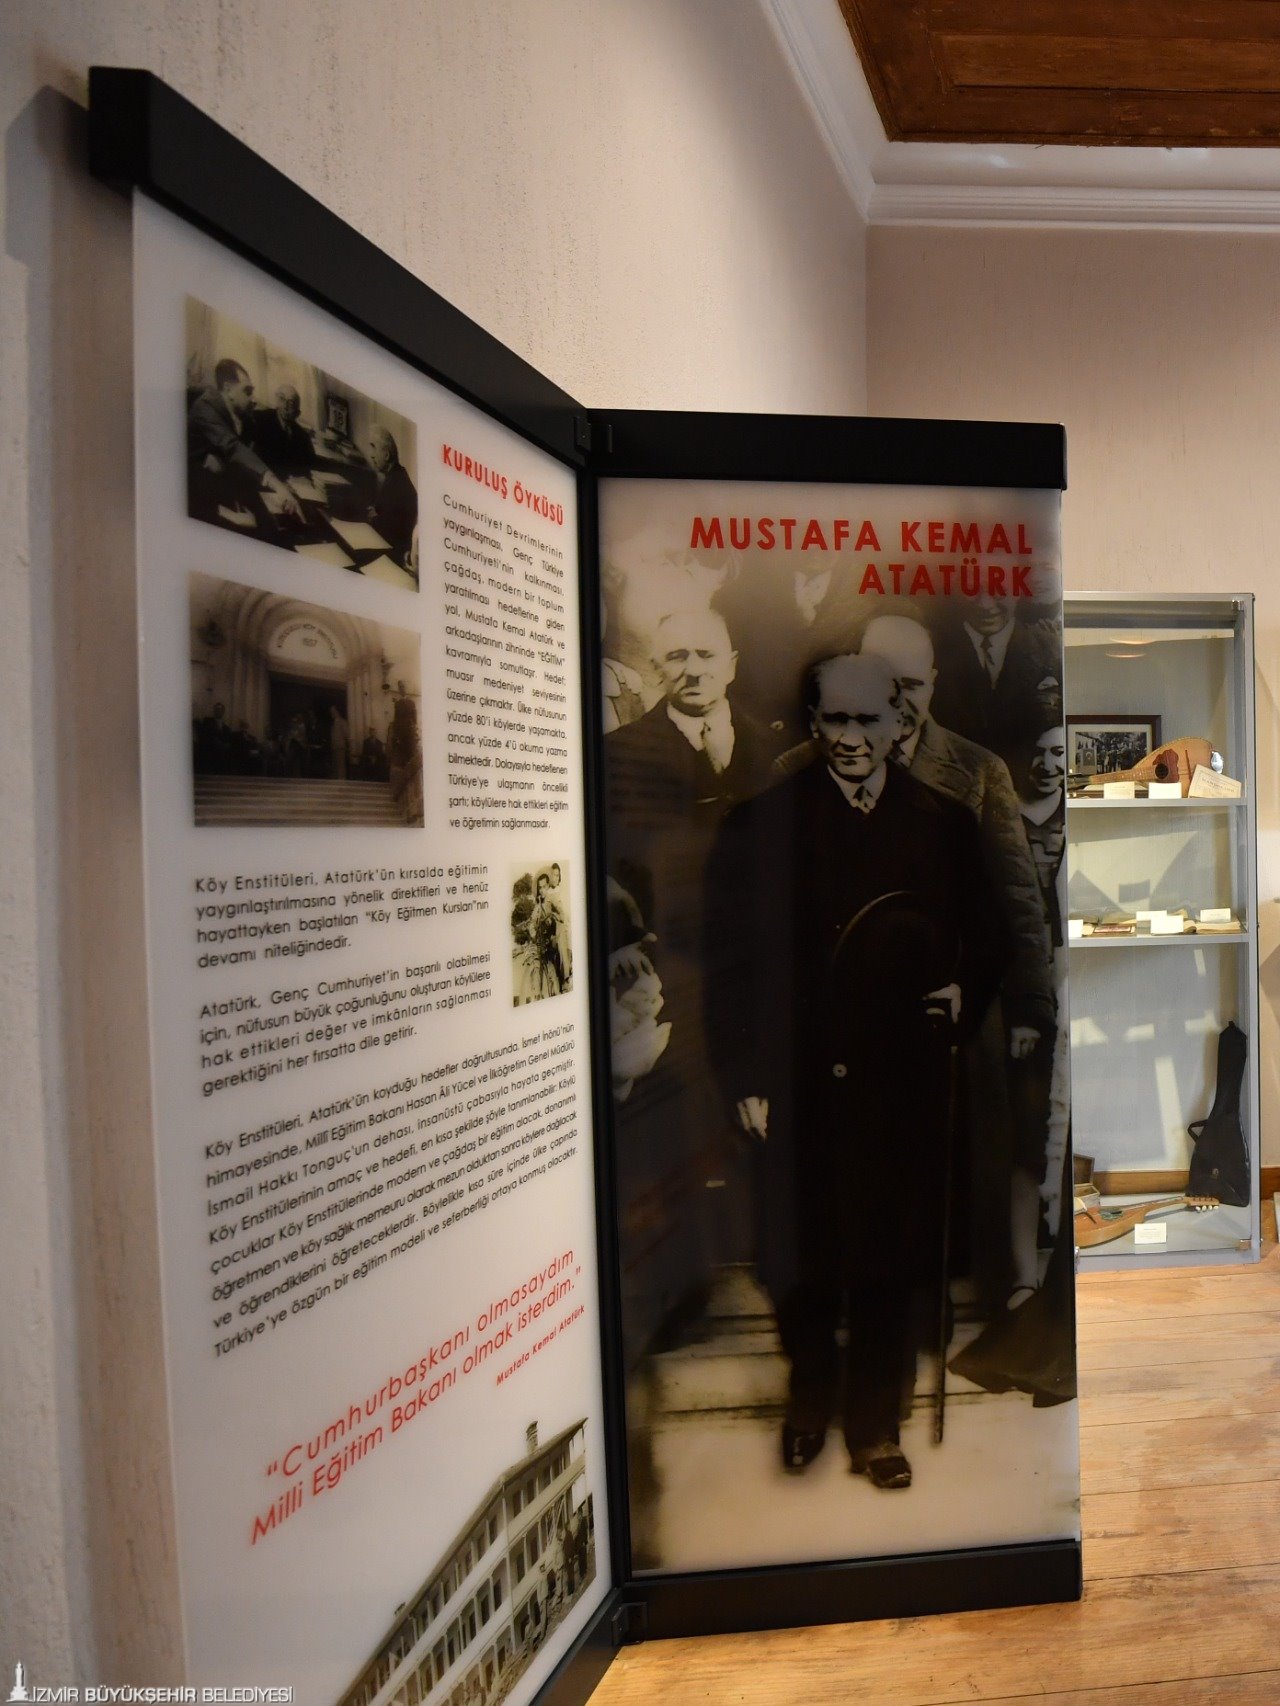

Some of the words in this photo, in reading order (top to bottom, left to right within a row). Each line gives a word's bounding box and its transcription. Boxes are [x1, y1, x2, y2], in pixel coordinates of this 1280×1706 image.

[442, 444, 508, 499] KURULUŞ
[513, 481, 564, 526] ÖYKÜSÜ
[690, 517, 881, 552] MUSTAFA
[901, 521, 1033, 555] KEMAL
[858, 557, 1033, 597] ATATÜRK
[194, 876, 228, 894] Köy
[324, 868, 395, 884] Atatürk'ün
[399, 866, 444, 879] kırsalda
[343, 889, 384, 907] yönelik
[196, 921, 291, 943] hayattayken
[298, 914, 358, 932] başlatılan
[397, 906, 437, 921] Eğitmen
[197, 950, 256, 968] devamı
[264, 934, 351, 958] niteliğindedir.
[235, 1014, 290, 1036] nüfusun
[293, 1003, 332, 1023] büyük
[334, 989, 407, 1016] çoğunluğunu
[269, 988, 309, 1005] Genç
[317, 969, 399, 995] Cumhuriyet'in
[200, 1048, 233, 1068] hak
[239, 1031, 300, 1059] ettikleri
[304, 1023, 348, 1043] değer
[351, 1018, 367, 1030] ve
[371, 1002, 432, 1026] imkânların
[202, 1059, 283, 1097] gerektiğini
[286, 1054, 309, 1070] her
[312, 1042, 356, 1063] fırsatta
[359, 1035, 380, 1050] dile
[383, 1025, 417, 1046] getirir.
[204, 1140, 233, 1159] Köy
[308, 1093, 369, 1123] Atatürk'ün
[373, 1077, 418, 1100] koyduğu
[420, 1062, 459, 1084] hedefler
[330, 1119, 366, 1141] Eğitim
[368, 1105, 404, 1126] Bakanı
[406, 1093, 437, 1112] Hasan
[438, 1085, 450, 1099] Âli
[207, 1185, 253, 1217] İsmail
[258, 1171, 298, 1195] Hakkı
[302, 1142, 370, 1177] Tonguç'un
[208, 1223, 238, 1245] Köy
[240, 1186, 324, 1231] Enstitülerinin
[327, 1169, 362, 1192] amaç
[365, 1162, 379, 1175] ve
[420, 1138, 434, 1151] en
[435, 1130, 453, 1145] kısa
[209, 1233, 276, 1276] çocuklar
[278, 1221, 303, 1241] Köy
[306, 1183, 384, 1228] Enstitülerinde
[386, 1164, 426, 1190] modern
[428, 1157, 440, 1169] ve
[211, 1259, 281, 1301] öğretmen
[282, 1250, 299, 1265] ve
[300, 1238, 322, 1257] köy
[406, 1180, 436, 1203] olarak
[212, 1311, 232, 1328] ve
[238, 1258, 327, 1316] öğrendiklerini
[330, 1213, 418, 1266] öğreteceklerdir.
[213, 1309, 287, 1357] Türkiye'ye
[291, 1285, 331, 1314] özgün
[333, 1273, 350, 1291] bir
[352, 1253, 388, 1280] eğitim
[390, 1228, 425, 1258] modeli
[427, 1224, 440, 1236] ve
[477, 1250, 573, 1332] olmasaydım
[496, 1353, 530, 1386] Mustafa
[532, 1325, 558, 1356] Kemal
[251, 1481, 303, 1543] Milli
[312, 1426, 383, 1496] Eğitim
[391, 1367, 456, 1433] Bakanı
[462, 1321, 513, 1374] olmak
